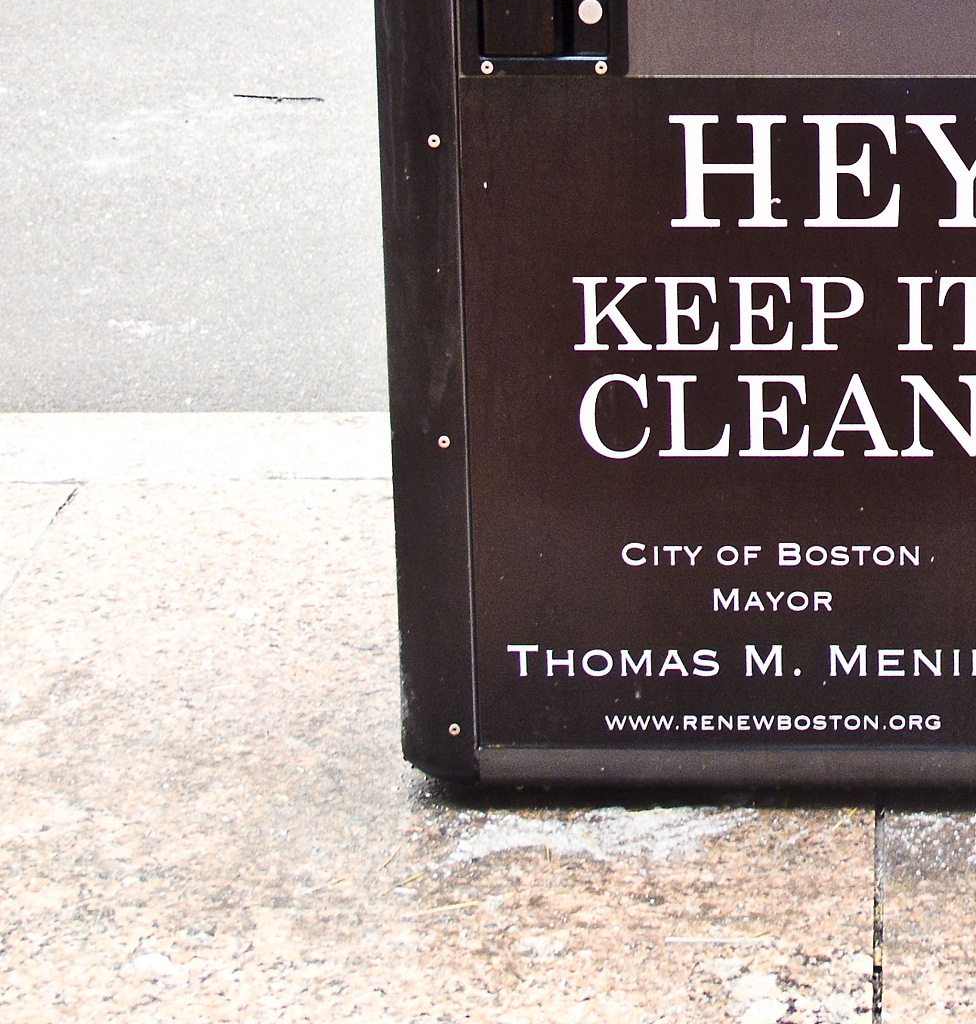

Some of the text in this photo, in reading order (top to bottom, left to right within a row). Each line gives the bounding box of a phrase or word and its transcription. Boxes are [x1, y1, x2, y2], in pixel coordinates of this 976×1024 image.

[572, 276, 865, 351] KEEP
[621, 542, 920, 566] CITY OF BOSTON
[712, 587, 833, 612] MAYOR
[506, 644, 720, 677] THOMAS
[745, 644, 802, 677] M.
[604, 713, 942, 732] WWW.RENEWBOSTON.ORG
